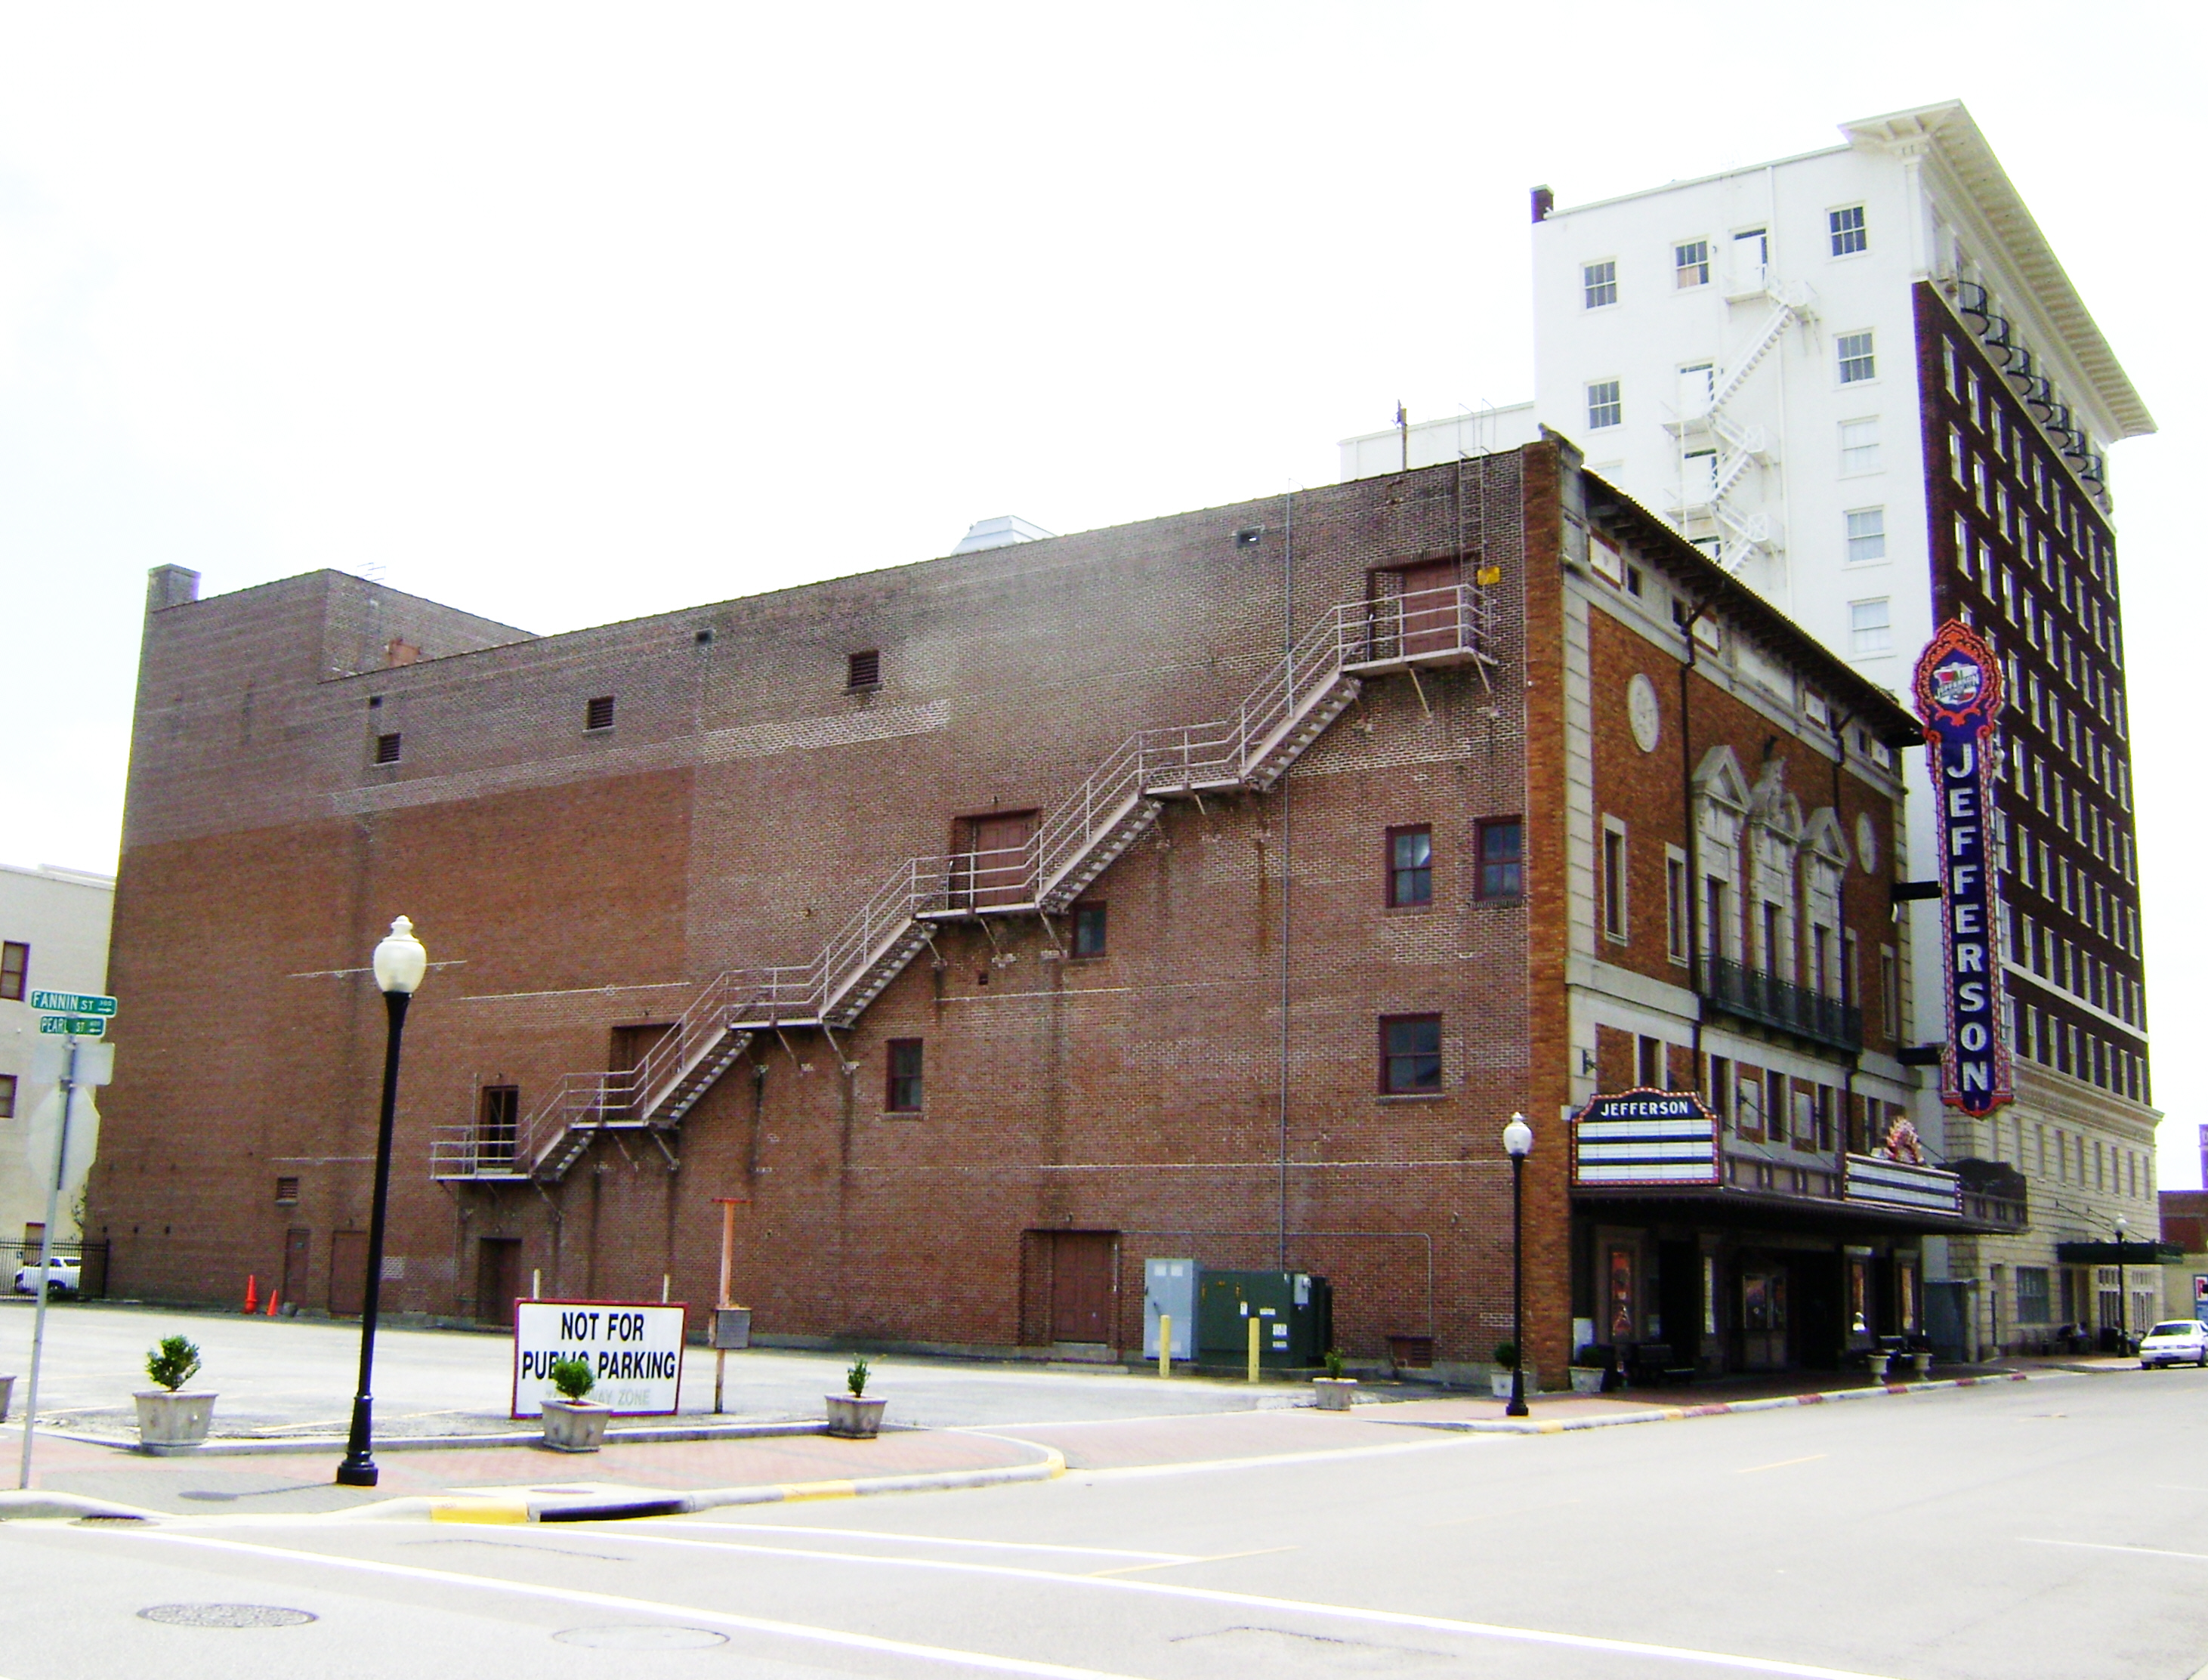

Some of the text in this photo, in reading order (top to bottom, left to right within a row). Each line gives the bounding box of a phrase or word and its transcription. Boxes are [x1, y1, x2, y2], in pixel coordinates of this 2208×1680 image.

[1945, 743, 1989, 1092] JEFFERSON
[33, 992, 79, 1010] FANNIN
[81, 999, 94, 1011] ST
[42, 1018, 68, 1033] PEARL
[76, 1021, 85, 1033] ST
[1601, 1101, 1688, 1116] JEFFERSON
[560, 1311, 644, 1342] NOT FOR
[598, 1351, 676, 1380] PARKING
[618, 1388, 651, 1406] ZONE
